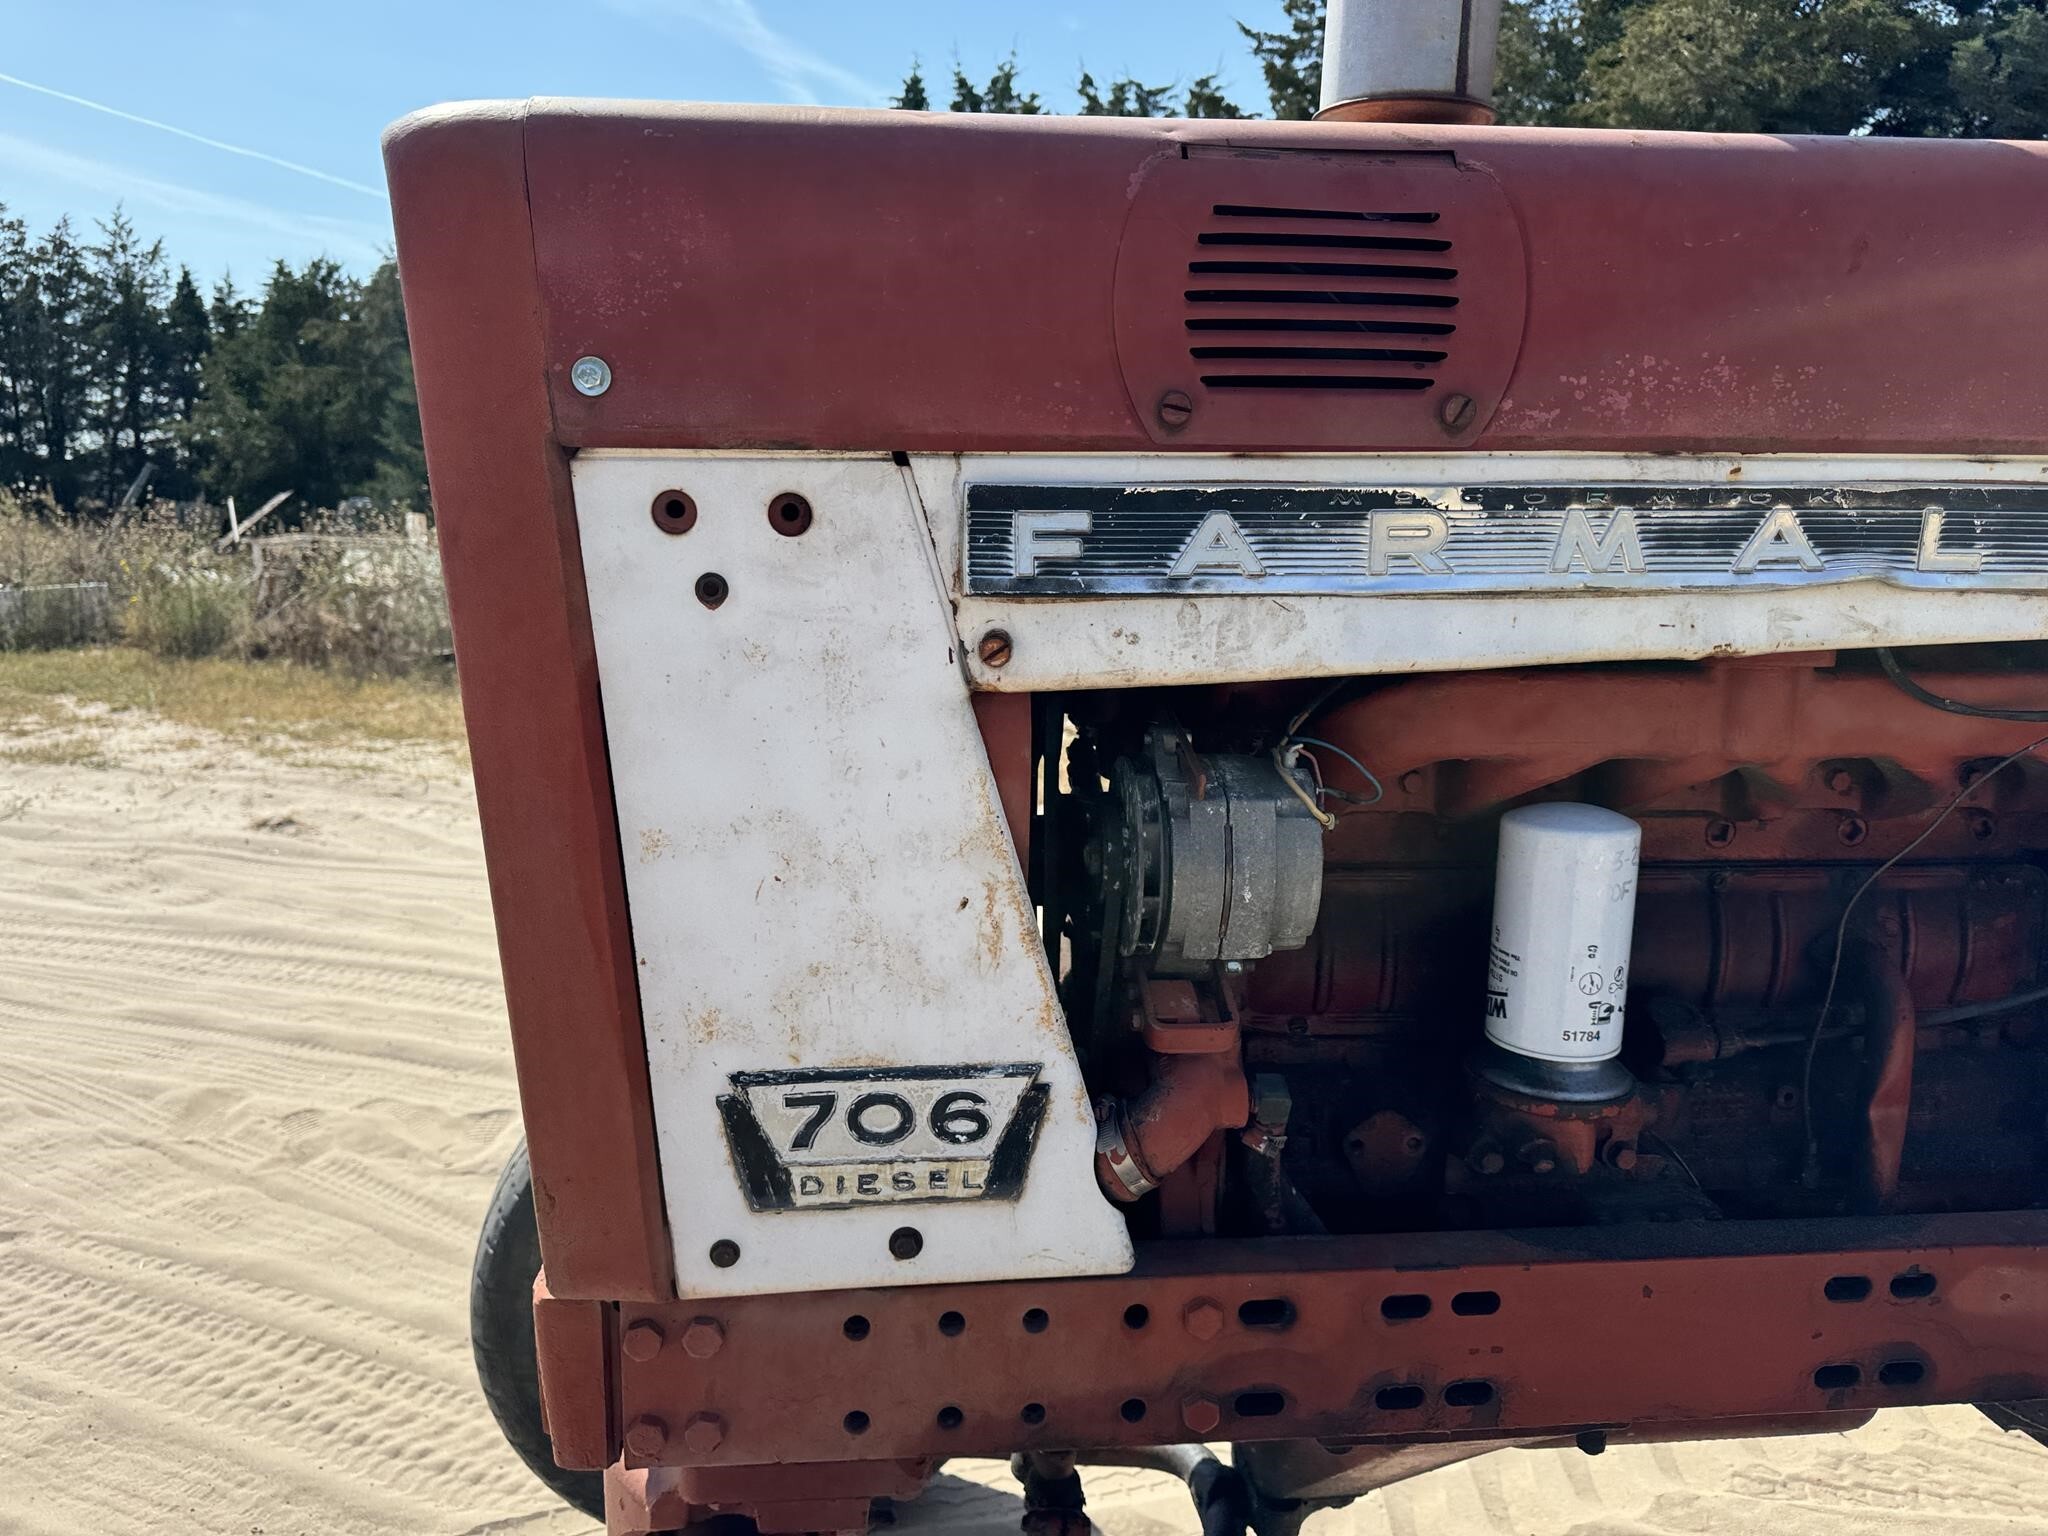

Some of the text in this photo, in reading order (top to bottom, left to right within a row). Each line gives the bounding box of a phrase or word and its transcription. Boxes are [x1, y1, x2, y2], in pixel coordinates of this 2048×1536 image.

[1562, 1030, 1601, 1042] 51784
[782, 1090, 992, 1152] 706
[800, 1168, 983, 1196] DIESEL
